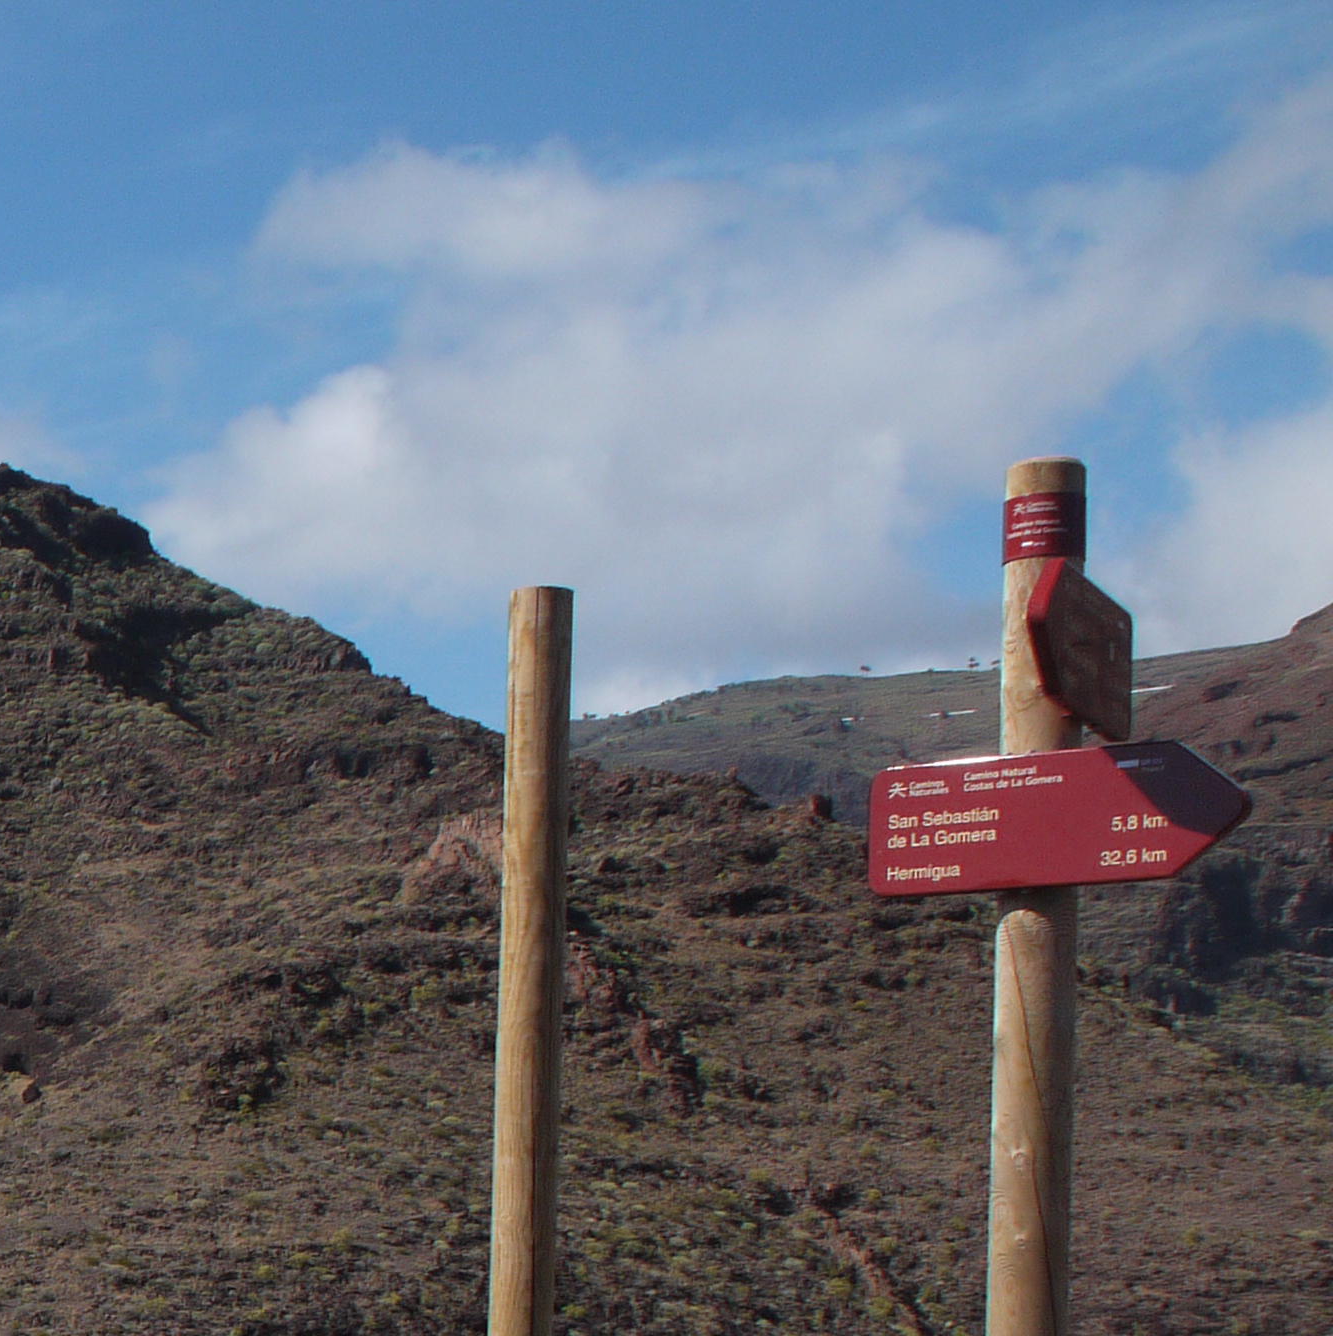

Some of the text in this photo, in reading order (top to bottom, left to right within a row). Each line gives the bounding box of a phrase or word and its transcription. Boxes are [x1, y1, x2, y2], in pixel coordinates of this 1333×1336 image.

[963, 766, 1037, 782] Camino Natural
[963, 774, 1063, 792] Costas de La Gomera
[909, 780, 945, 790] Caminos
[909, 787, 949, 797] Naturales
[888, 807, 999, 830] San Sebastián
[1110, 814, 1168, 832] 5,8 km
[887, 829, 997, 849] de La Gomera
[1099, 848, 1167, 867] 32,6 km
[886, 864, 961, 881] Hermigua
